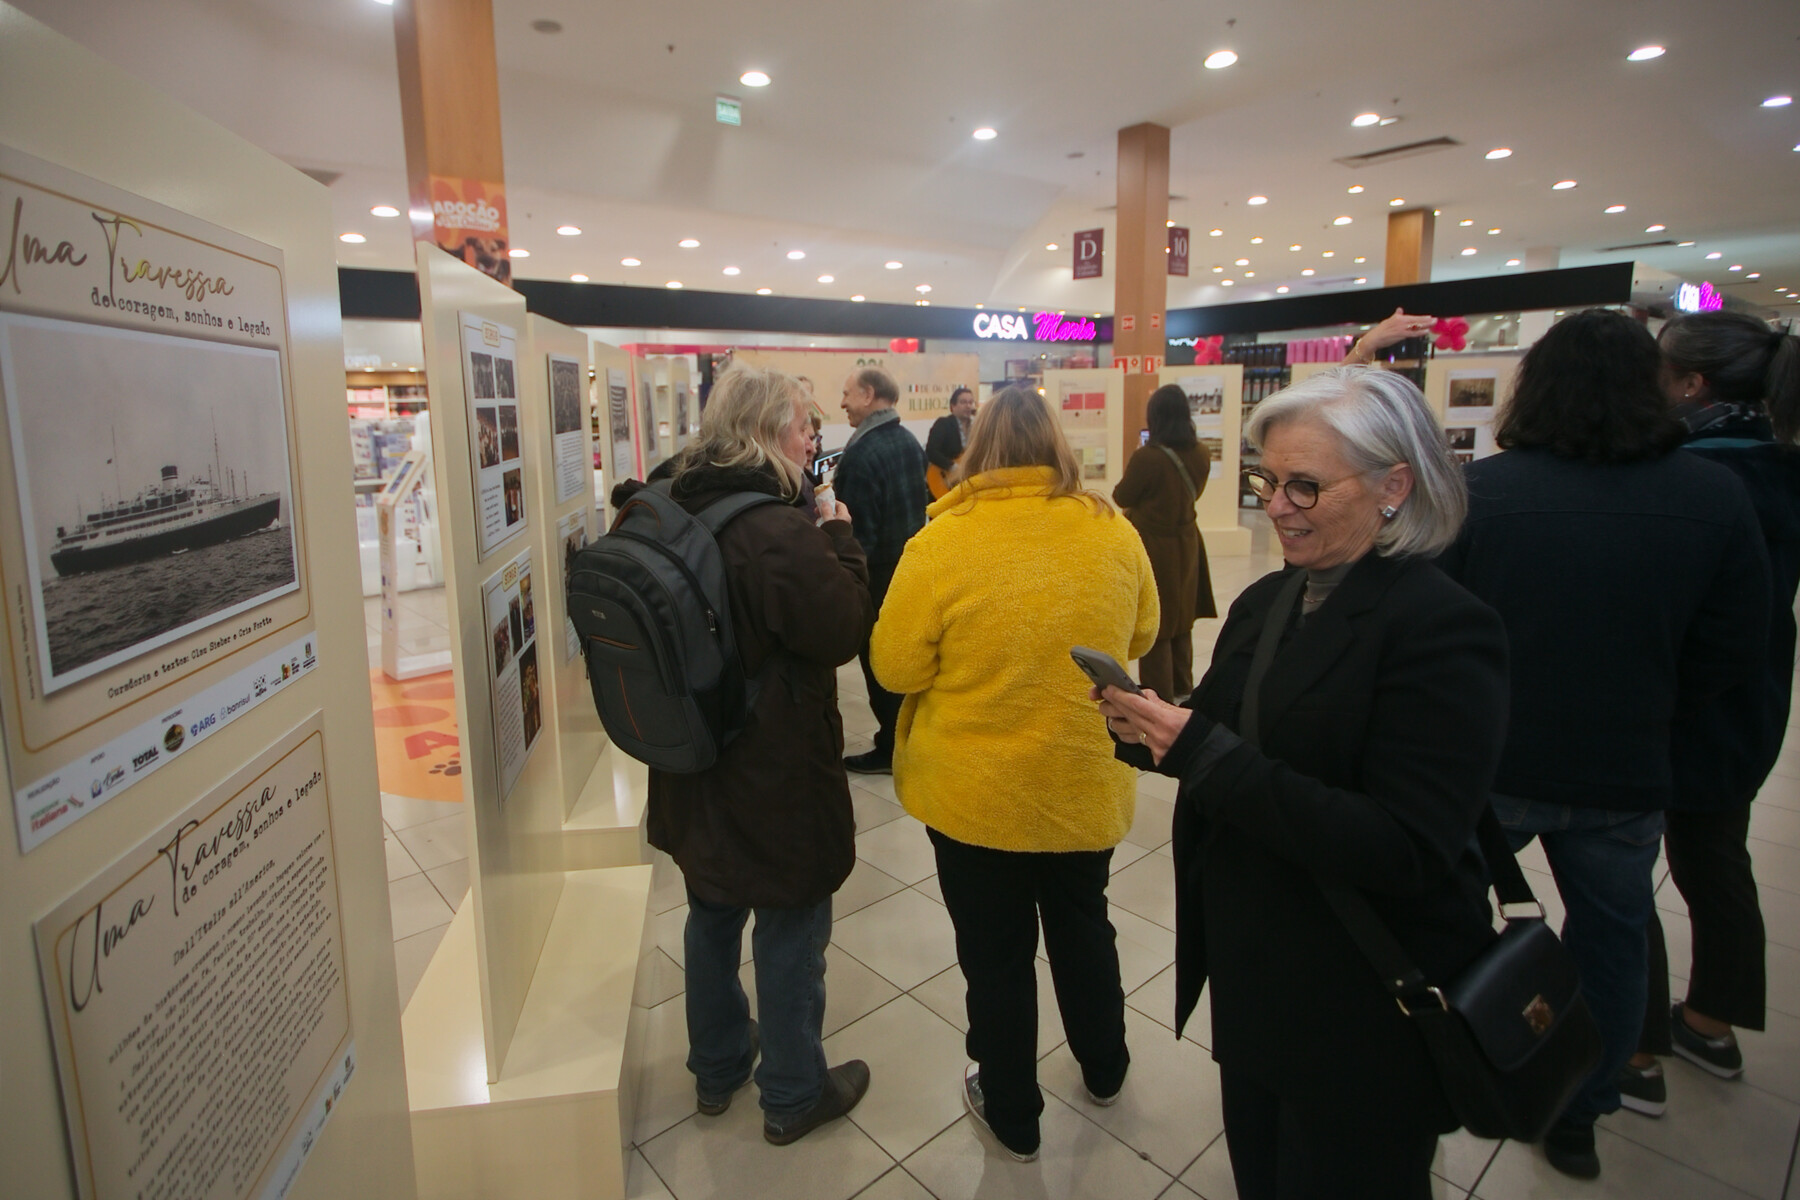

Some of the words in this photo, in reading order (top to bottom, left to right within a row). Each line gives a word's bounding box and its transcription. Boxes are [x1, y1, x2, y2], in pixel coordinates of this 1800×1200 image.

[434, 199, 499, 221] ADOÇÃO
[1080, 240, 1096, 260] D
[1174, 238, 1187, 257] 10
[92, 212, 234, 307] Travessia
[92, 287, 110, 308] de
[118, 298, 179, 323] coragem,
[185, 309, 222, 328] sonhos
[228, 319, 234, 330] e
[238, 316, 270, 338] legado
[973, 313, 1028, 340] CASA
[226, 694, 251, 716] banrisul
[198, 712, 216, 734] ARG
[132, 746, 159, 768] TOTAL
[182, 885, 197, 903] de
[202, 841, 250, 885] coragem,
[253, 808, 284, 839] sonhos
[287, 798, 293, 809] e
[295, 771, 322, 799] legado
[69, 894, 155, 1011] Uma
[158, 784, 276, 917] Travessia
